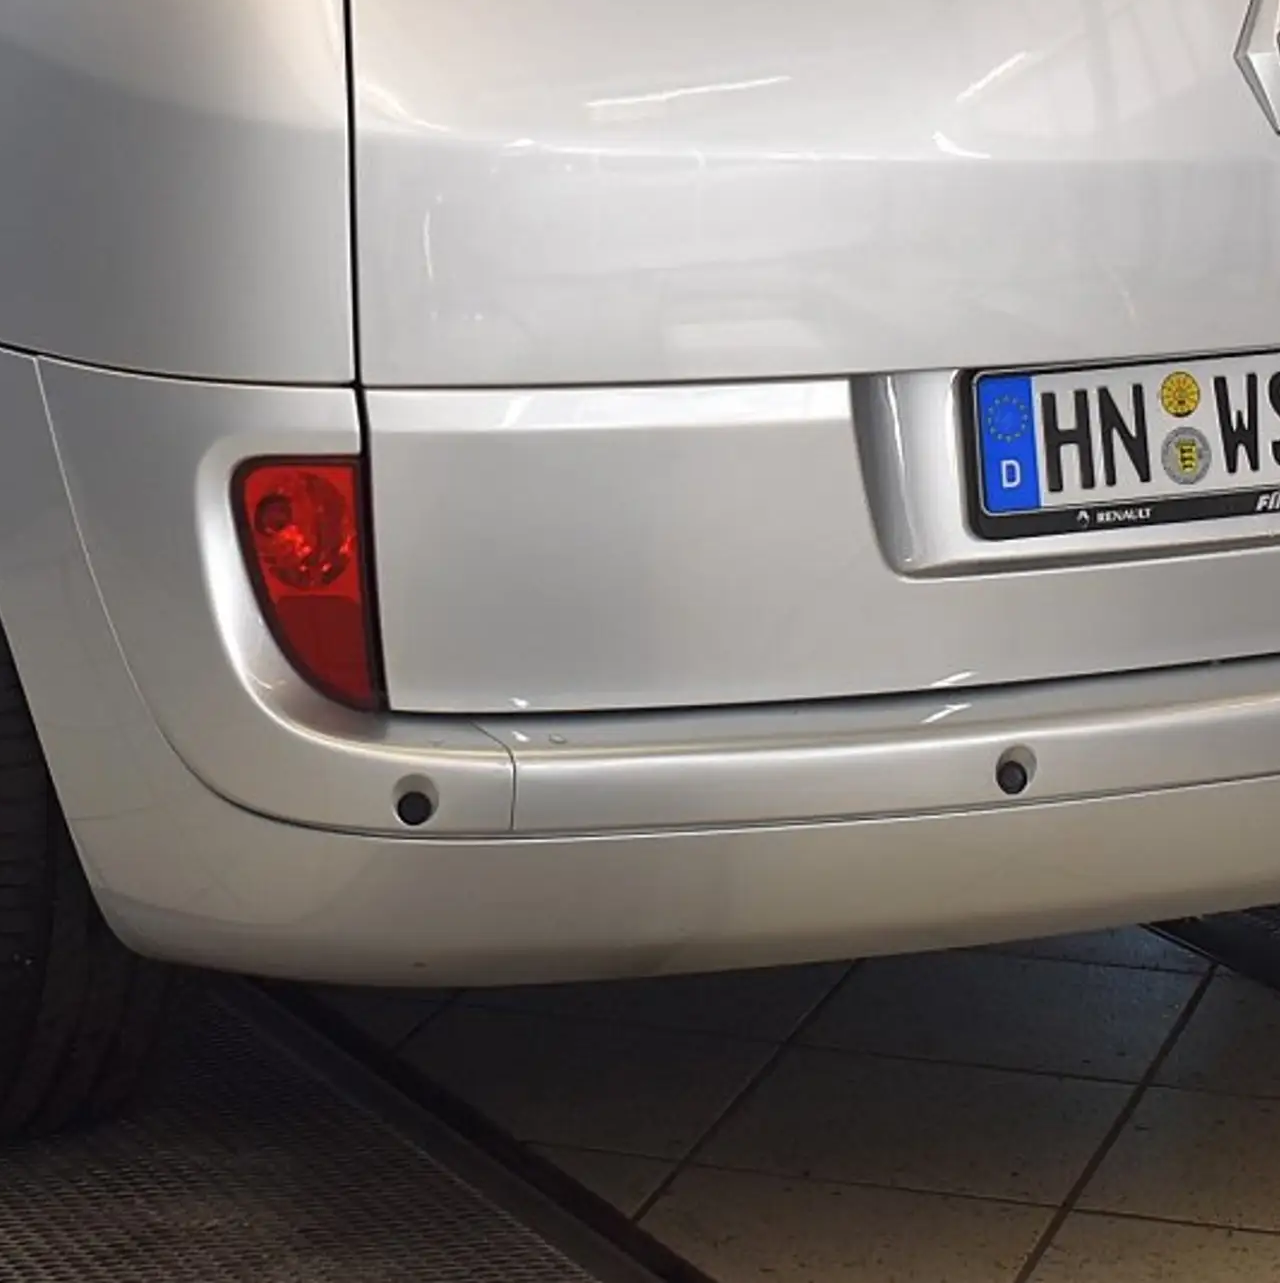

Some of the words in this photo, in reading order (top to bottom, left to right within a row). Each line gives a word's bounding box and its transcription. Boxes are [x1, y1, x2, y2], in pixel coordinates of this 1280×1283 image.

[1040, 383, 1152, 493] HN
[1001, 459, 1021, 489] D
[1096, 507, 1152, 523] RENAULT
